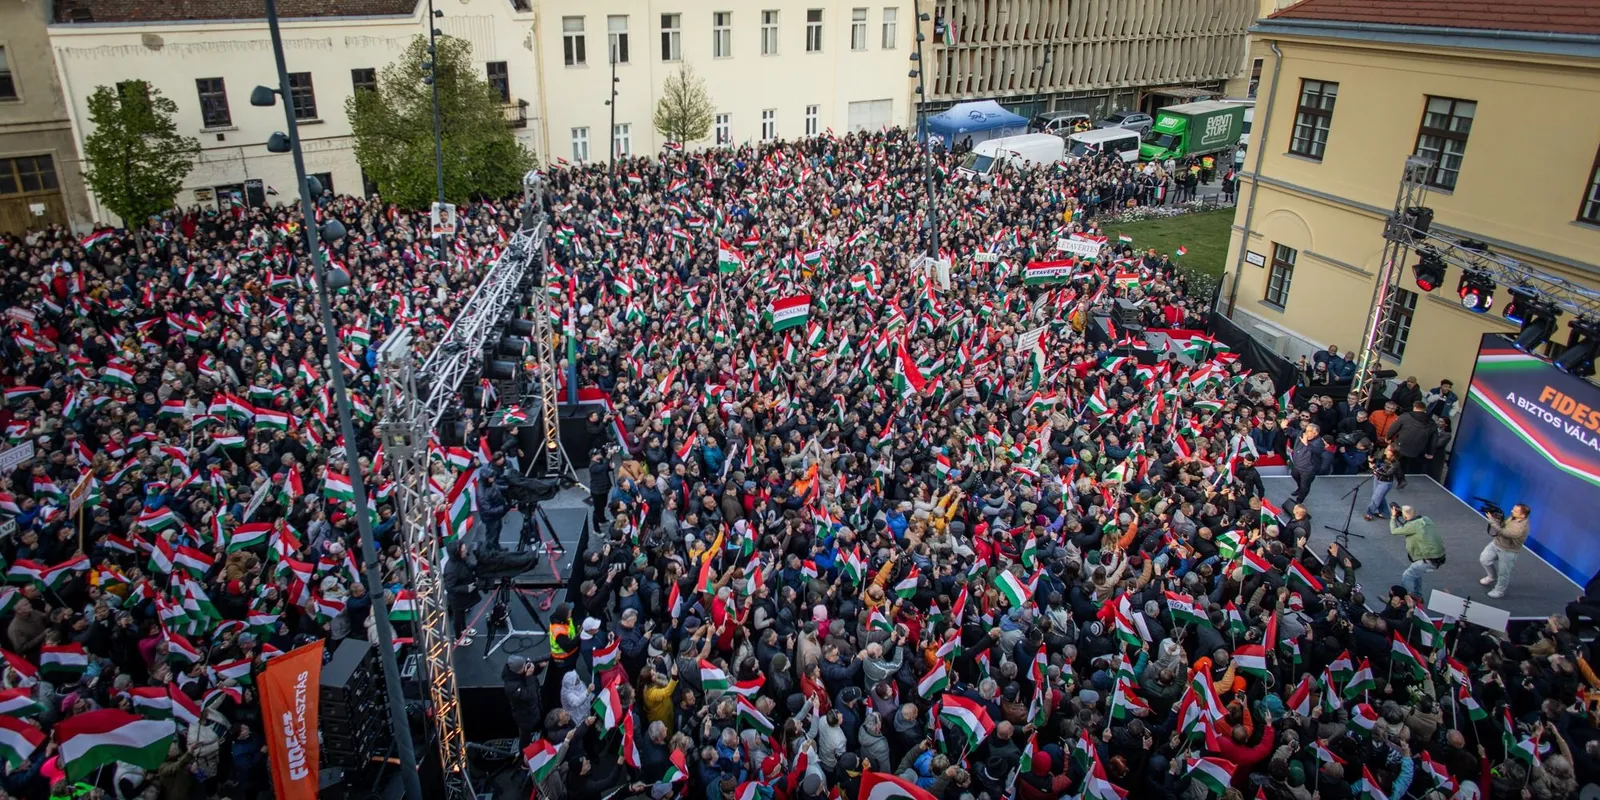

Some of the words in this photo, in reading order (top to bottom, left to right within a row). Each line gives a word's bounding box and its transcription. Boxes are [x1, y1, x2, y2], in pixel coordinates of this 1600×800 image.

[1205, 124, 1227, 137] STUFF
[1206, 113, 1231, 128] EVENT
[1506, 392, 1516, 403] A
[1517, 397, 1561, 428] BIZTOS
[1564, 421, 1600, 452] VÁLA
[1539, 385, 1600, 435] FIDES
